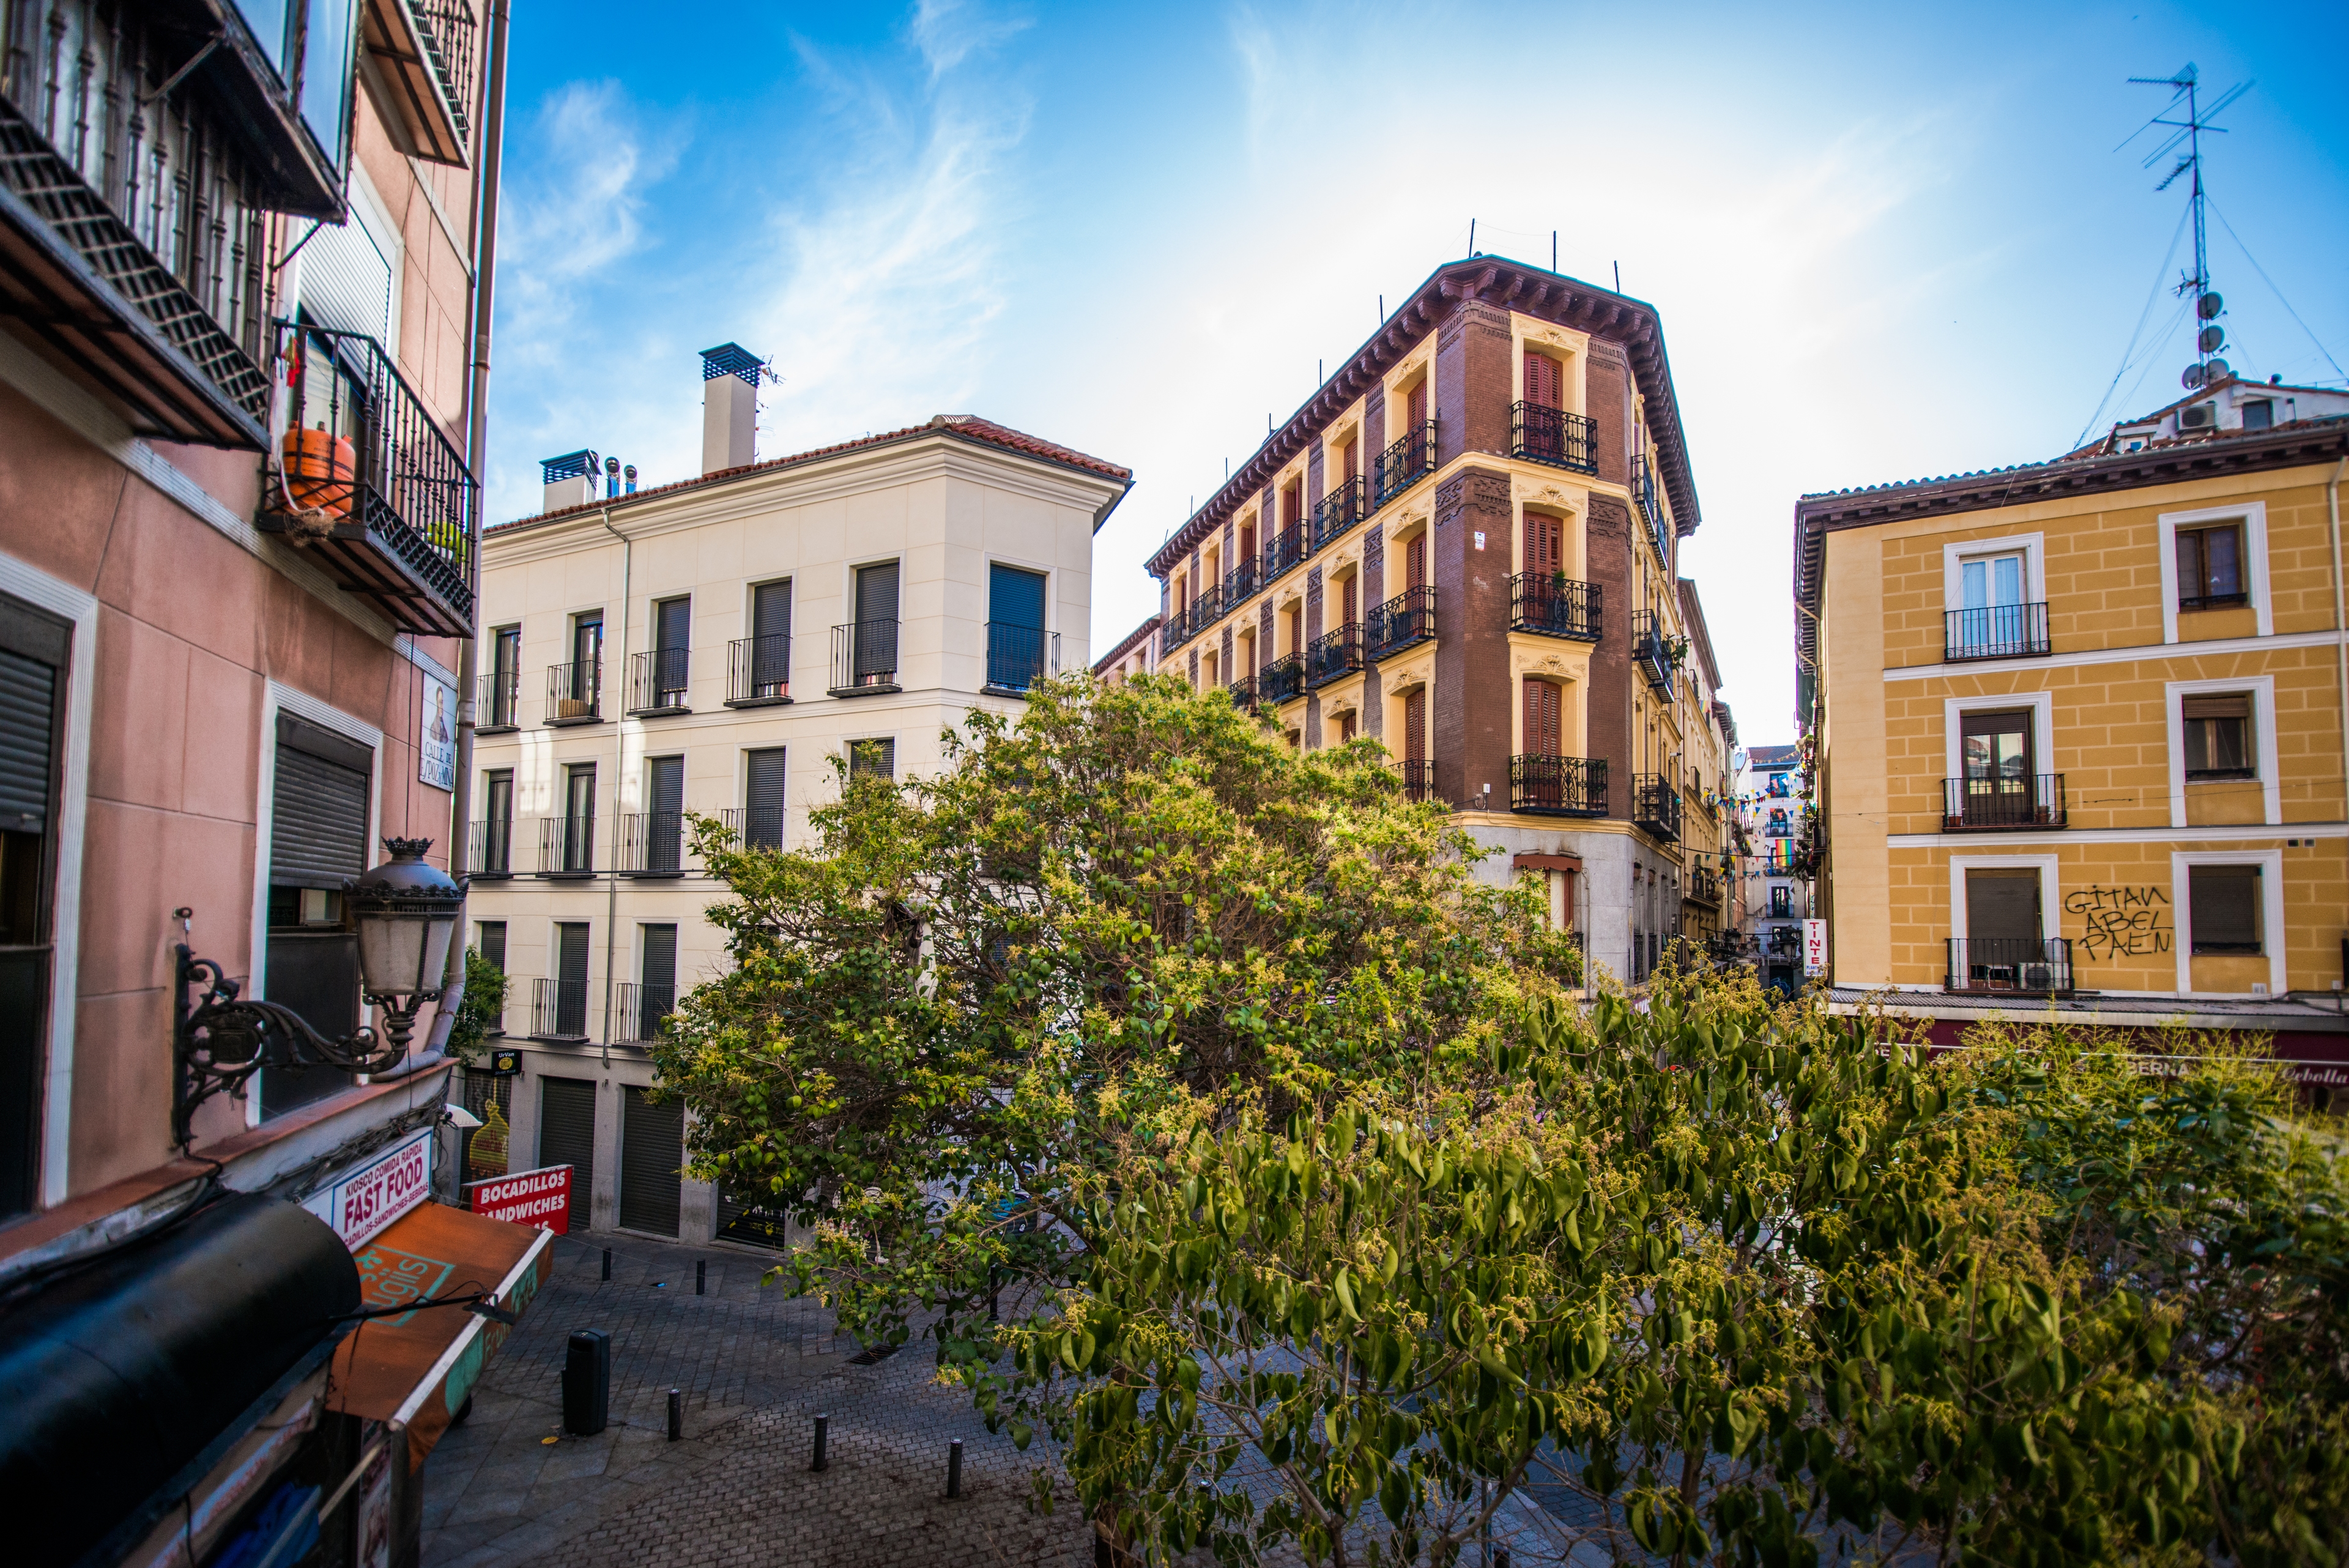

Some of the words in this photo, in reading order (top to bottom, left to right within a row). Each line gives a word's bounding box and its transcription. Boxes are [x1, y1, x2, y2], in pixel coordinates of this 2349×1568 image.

[425, 741, 444, 763] CALLE
[446, 752, 451, 764] DE
[420, 757, 439, 782] ESPOZ
[442, 765, 454, 788] MINA
[2086, 910, 2174, 934] ABEL
[1809, 922, 1821, 964] TINTE
[2079, 931, 2170, 962] PAEN
[490, 1129, 497, 1140] EL
[346, 1171, 373, 1198] KIOSCO
[374, 1155, 399, 1181] COMIDA
[480, 1171, 566, 1205] BOCADILLOS
[344, 1180, 382, 1234] FAST
[387, 1156, 423, 1205] FOOD
[480, 1194, 566, 1222] NDWICHES
[344, 1182, 429, 1249] CADILLOS-SANDWICHES-BEBIDAS
